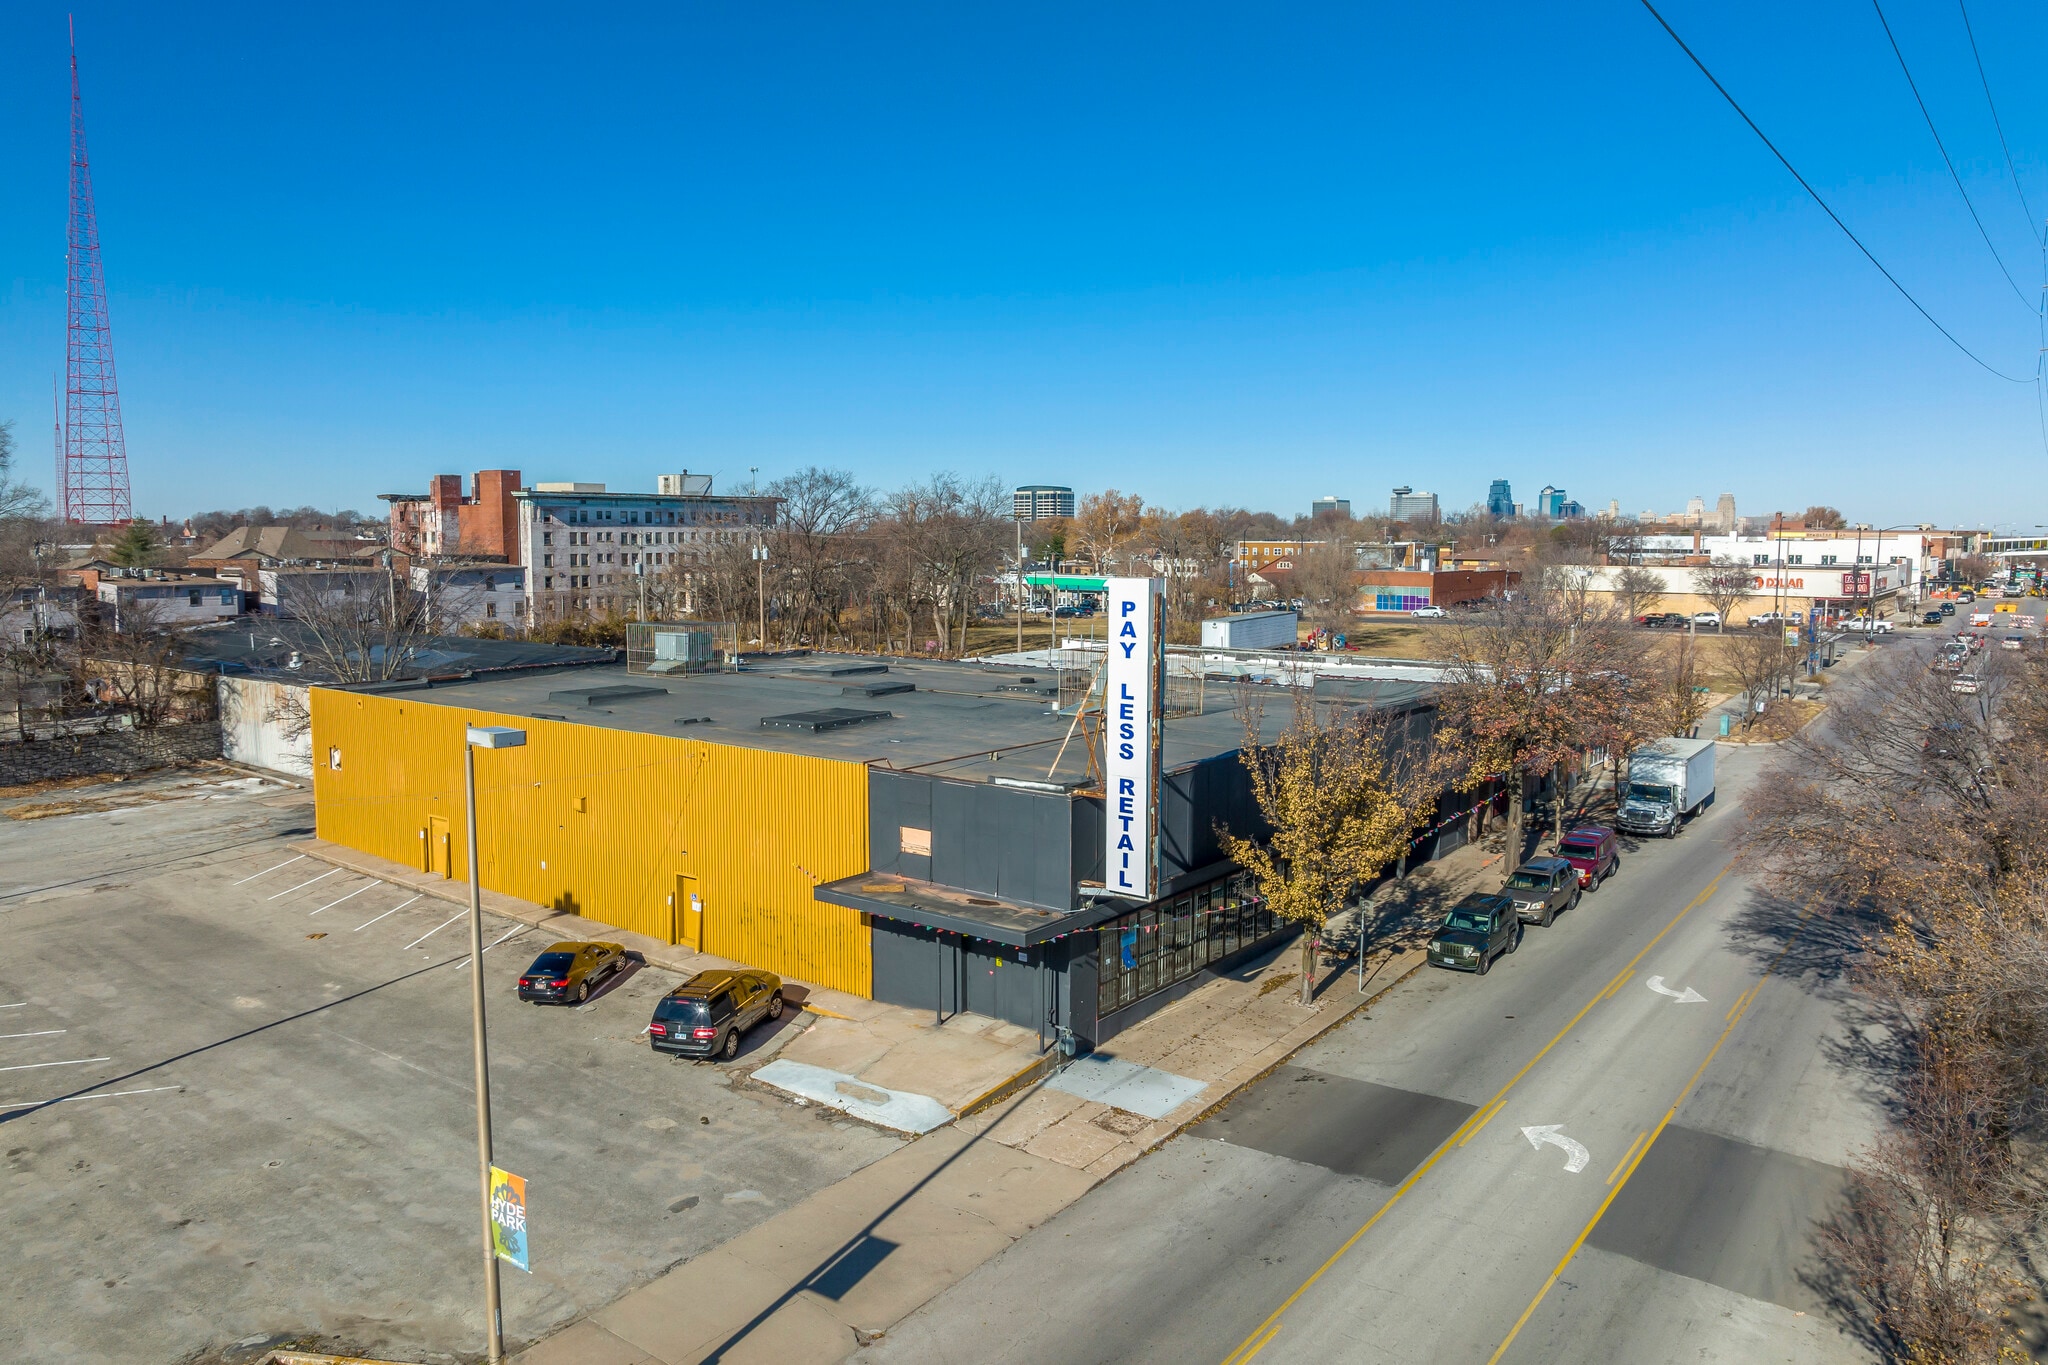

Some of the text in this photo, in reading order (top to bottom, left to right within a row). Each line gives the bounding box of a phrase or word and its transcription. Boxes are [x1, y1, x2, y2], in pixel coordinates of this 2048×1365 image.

[1844, 575, 1868, 583] FAILY
[1117, 601, 1136, 888] PAY LESS RETAIL
[492, 1195, 526, 1219] HYDE
[492, 1209, 526, 1233] PARK
